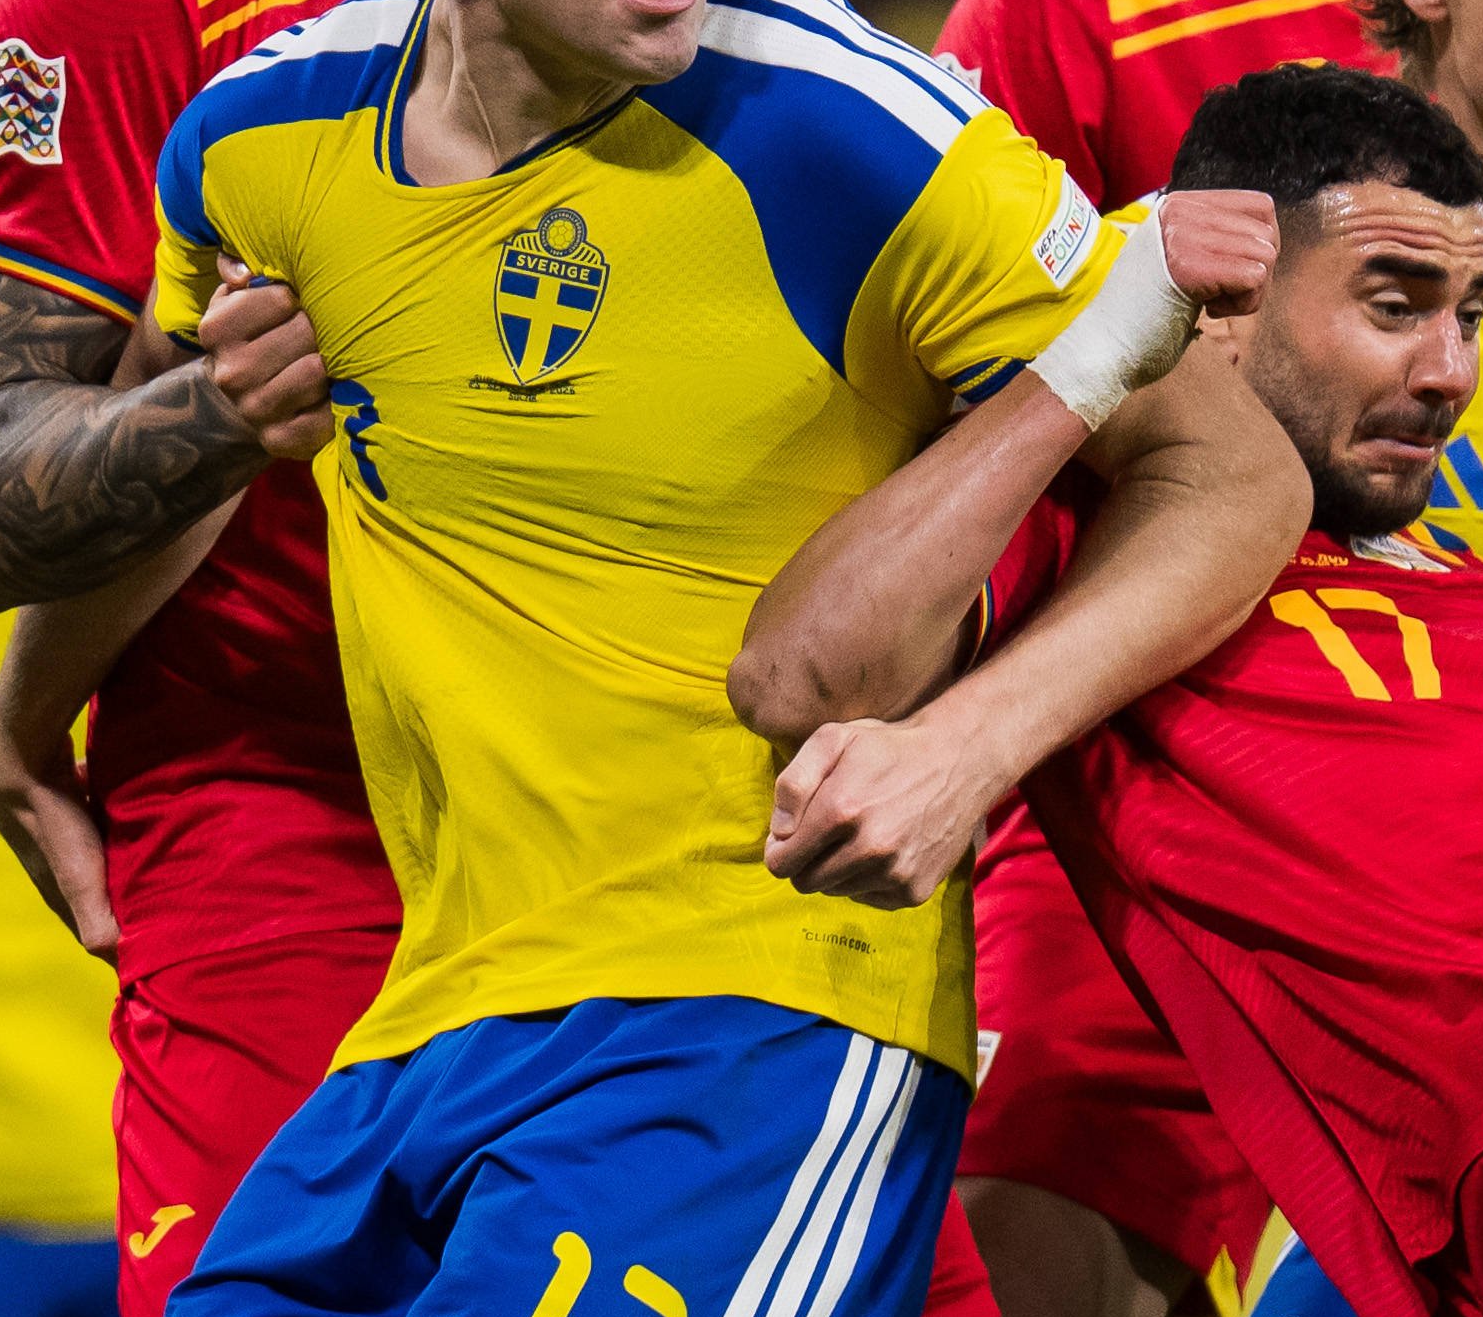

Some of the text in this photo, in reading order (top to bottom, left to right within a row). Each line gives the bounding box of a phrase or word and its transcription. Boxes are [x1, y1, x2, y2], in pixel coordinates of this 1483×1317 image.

[1037, 228, 1059, 258] UEFA
[516, 254, 590, 282] SVERIGE
[1269, 588, 1441, 702] 17
